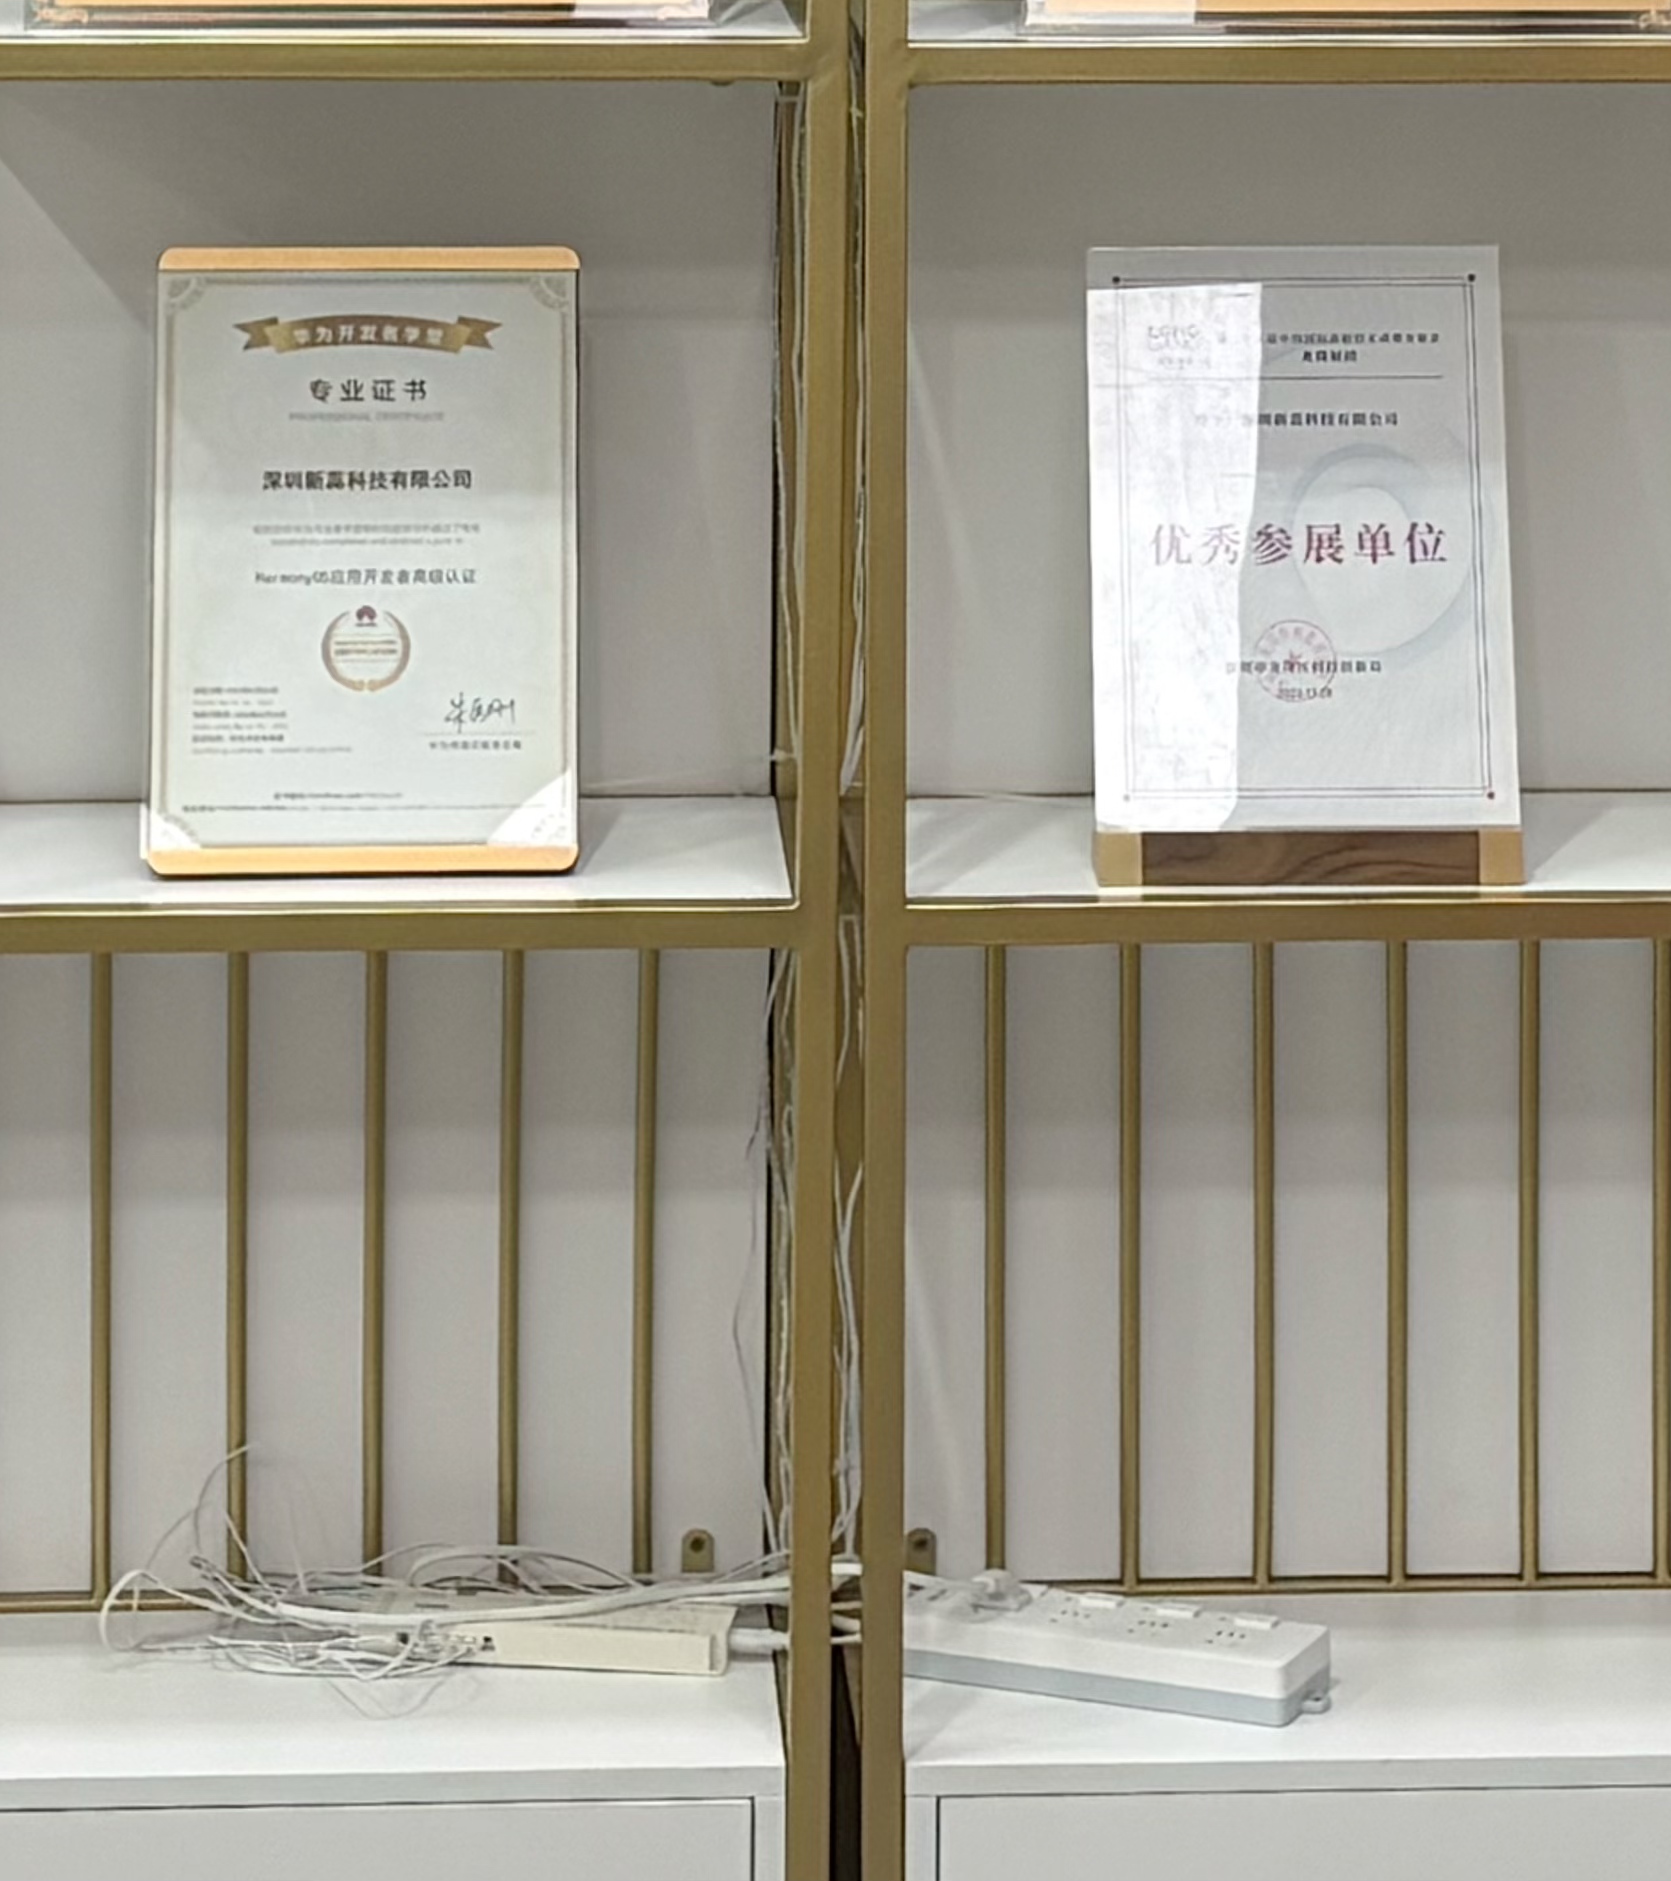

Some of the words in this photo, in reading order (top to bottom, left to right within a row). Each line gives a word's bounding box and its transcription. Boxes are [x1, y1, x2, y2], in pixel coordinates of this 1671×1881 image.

[309, 379, 427, 403] 专业证书
[1150, 522, 1449, 566] 优秀参展单位
